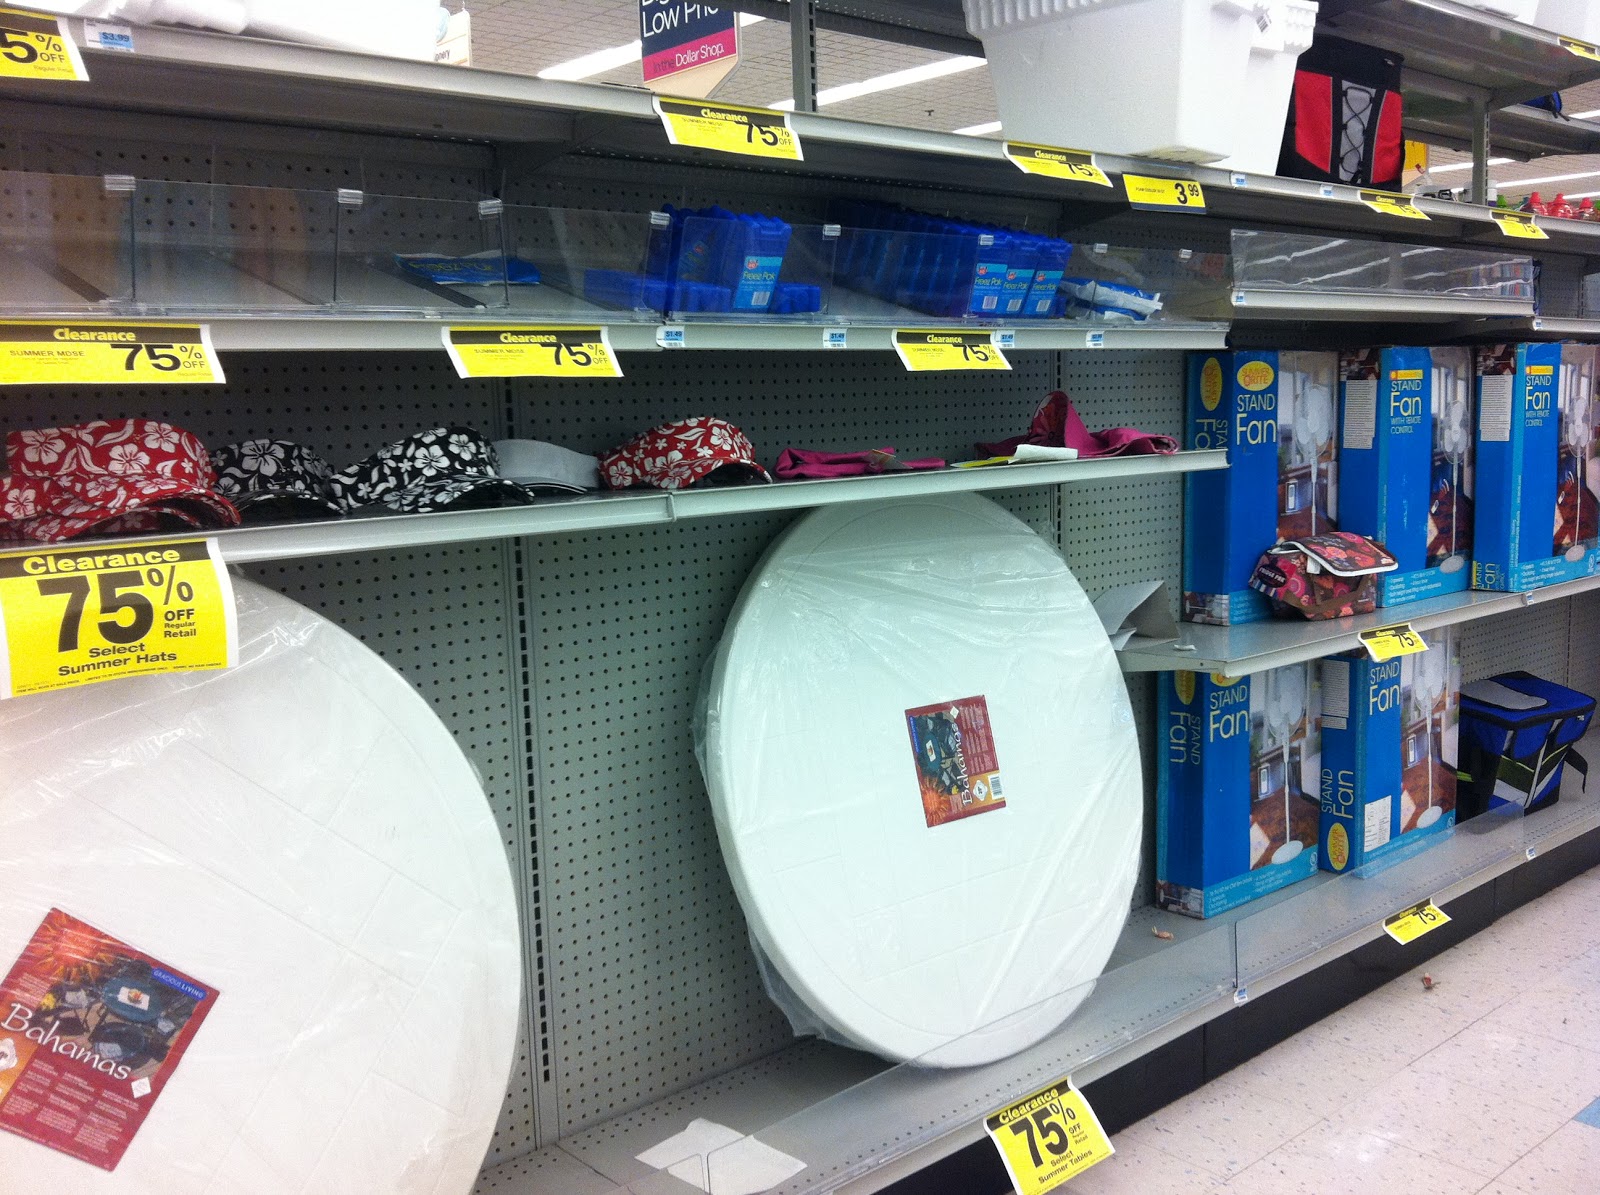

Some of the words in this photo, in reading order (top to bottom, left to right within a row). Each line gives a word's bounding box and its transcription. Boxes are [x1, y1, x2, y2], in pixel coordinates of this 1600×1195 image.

[642, 5, 680, 38] Low
[0, 27, 63, 64] 5%
[39, 52, 65, 63] OFF
[675, 49, 700, 67] Dollar
[701, 108, 749, 123] Clearance
[1034, 150, 1067, 161] Clearance
[53, 328, 136, 341] Clearance
[500, 332, 557, 343] Clearance
[926, 335, 963, 344] Clearance
[110, 343, 202, 372] 75%
[182, 361, 205, 369] OFF
[539, 343, 606, 366] 75%
[1390, 380, 1422, 392] STAND
[1526, 375, 1552, 386] STAND
[1237, 394, 1276, 412] STAND
[1390, 391, 1422, 417] Fan
[1525, 386, 1551, 410] Fan
[1236, 413, 1277, 446] Fan
[1391, 417, 1405, 425] WITH
[1194, 418, 1216, 450] Fa
[1216, 419, 1228, 449] STA
[23, 549, 181, 575] Clearance
[36, 565, 195, 653] 75%
[163, 608, 196, 622] OFF
[163, 629, 197, 638] Retail
[164, 621, 196, 630] Regular
[88, 643, 146, 659] Select
[58, 657, 131, 677] Summer
[136, 651, 178, 665] Hats
[1370, 661, 1400, 685] STAND
[1209, 685, 1248, 710] STAND
[1369, 684, 1400, 716] Fan
[1169, 711, 1191, 763] Fan
[1209, 709, 1249, 743] Fan
[1190, 714, 1201, 765] STAND
[951, 723, 973, 806] Bahamas
[1321, 768, 1333, 814] STAND
[1332, 769, 1354, 819] Fan
[180, 983, 204, 999] LIVING
[1, 1003, 132, 1080] Bahamas
[999, 1088, 1059, 1124] Clearance
[1009, 1098, 1077, 1169] 75%
[1068, 1122, 1082, 1134] OFF
[1038, 1164, 1069, 1185] Summer
[1069, 1149, 1093, 1166] Tables
[1050, 1150, 1075, 1168] Select
